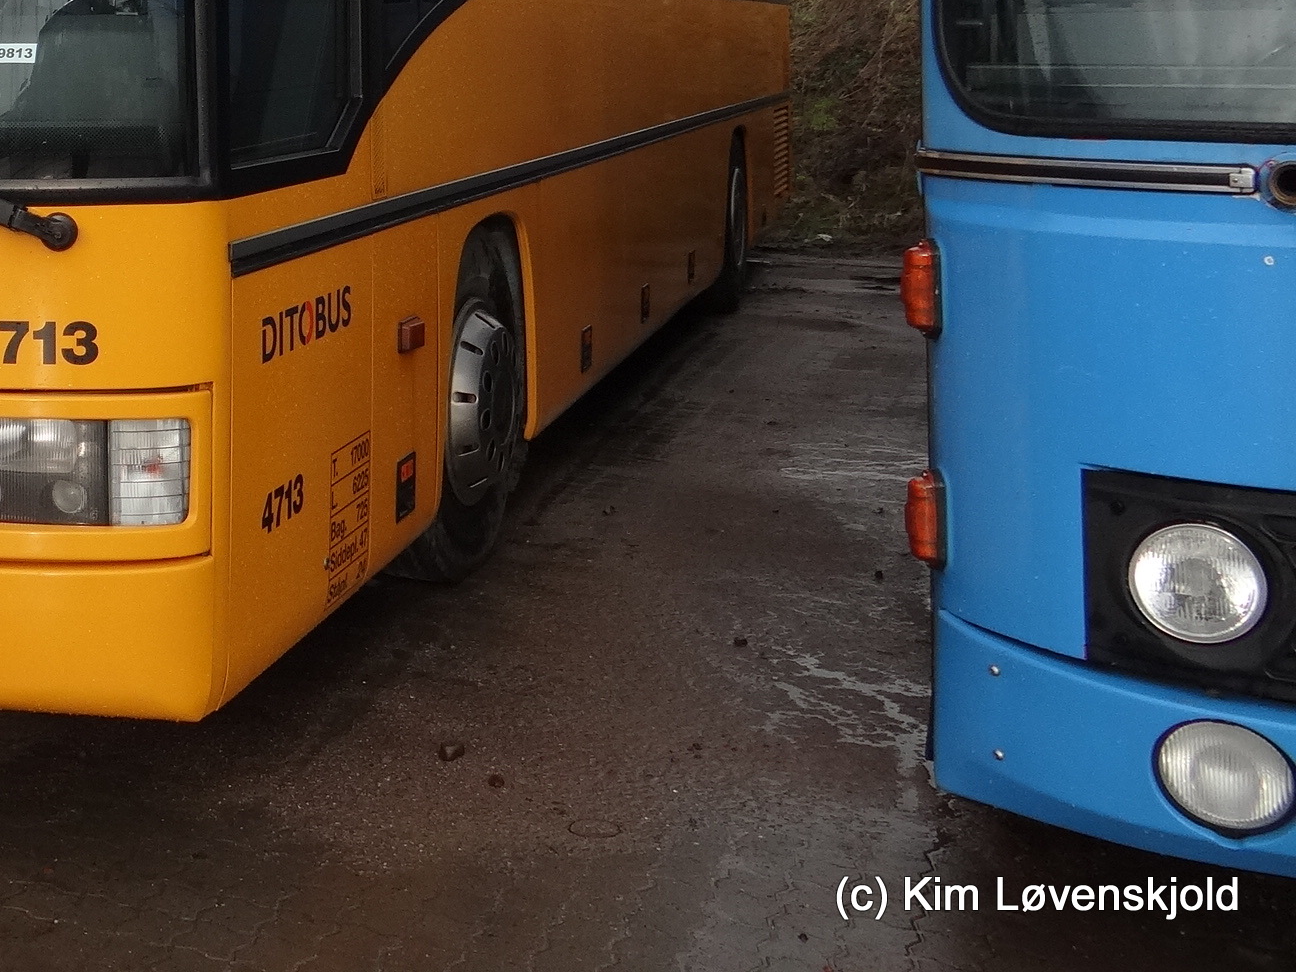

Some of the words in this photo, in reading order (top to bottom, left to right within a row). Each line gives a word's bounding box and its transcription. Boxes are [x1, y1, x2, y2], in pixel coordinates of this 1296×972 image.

[262, 285, 351, 364] DITOBUS
[350, 438, 370, 466] 17000
[352, 468, 369, 494] 6225
[262, 474, 304, 534] 4713
[330, 519, 348, 542] Bag.
[356, 498, 368, 523] 725
[359, 528, 368, 548] 47
